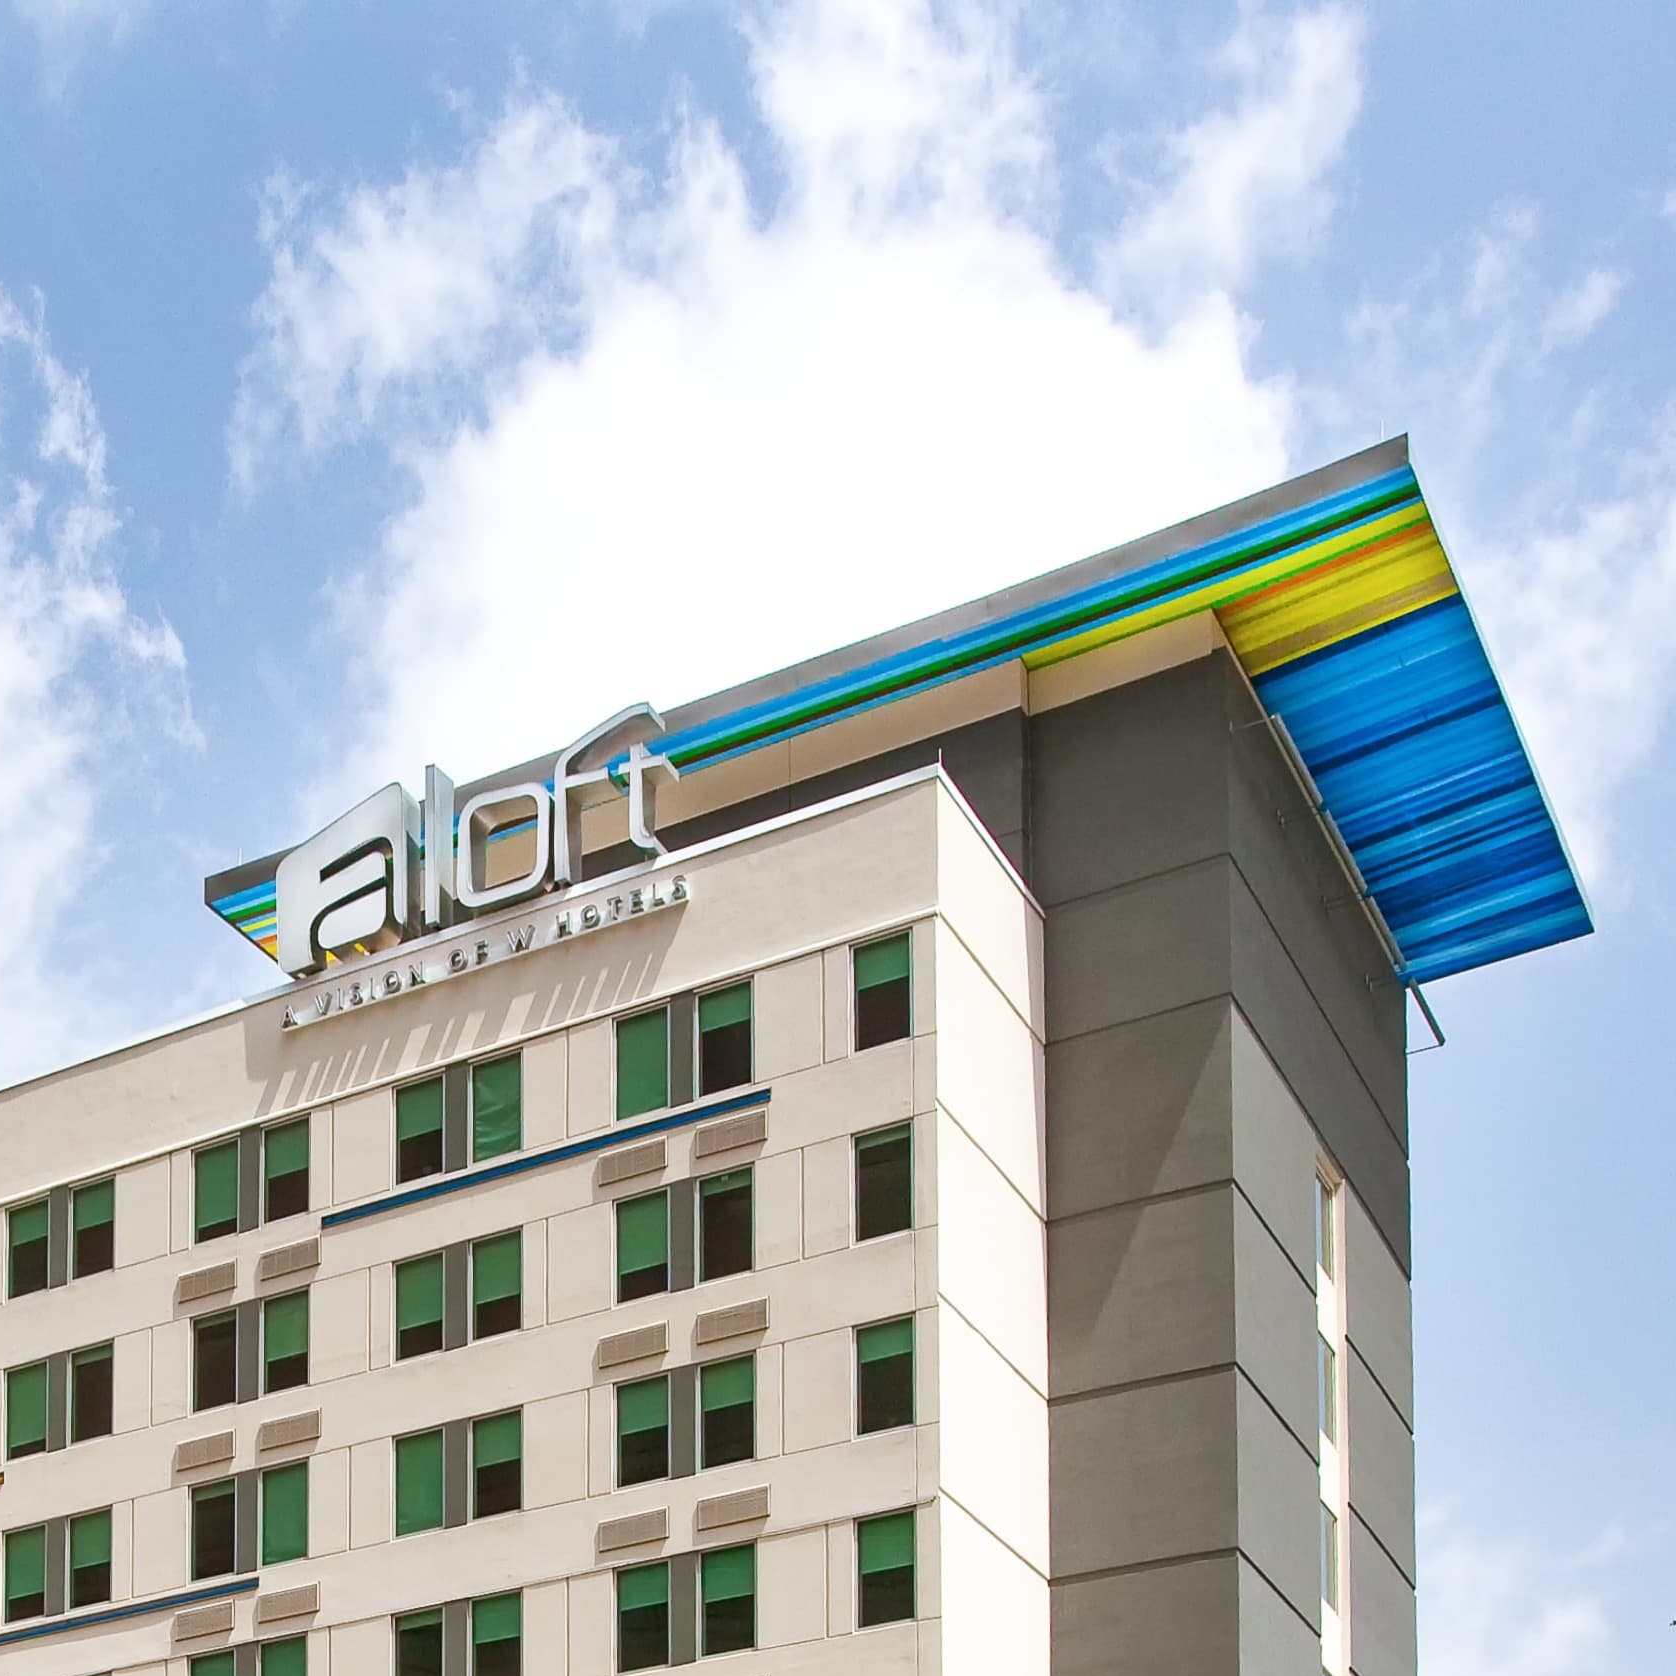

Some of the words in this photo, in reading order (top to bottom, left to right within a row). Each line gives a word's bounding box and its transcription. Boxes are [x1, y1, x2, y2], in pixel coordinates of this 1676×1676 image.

[276, 702, 680, 978] aloft
[280, 1004, 298, 1029] A
[314, 961, 426, 1016] VISION
[446, 940, 489, 972] OF
[508, 924, 536, 953] W
[556, 875, 688, 939] HOTELS
